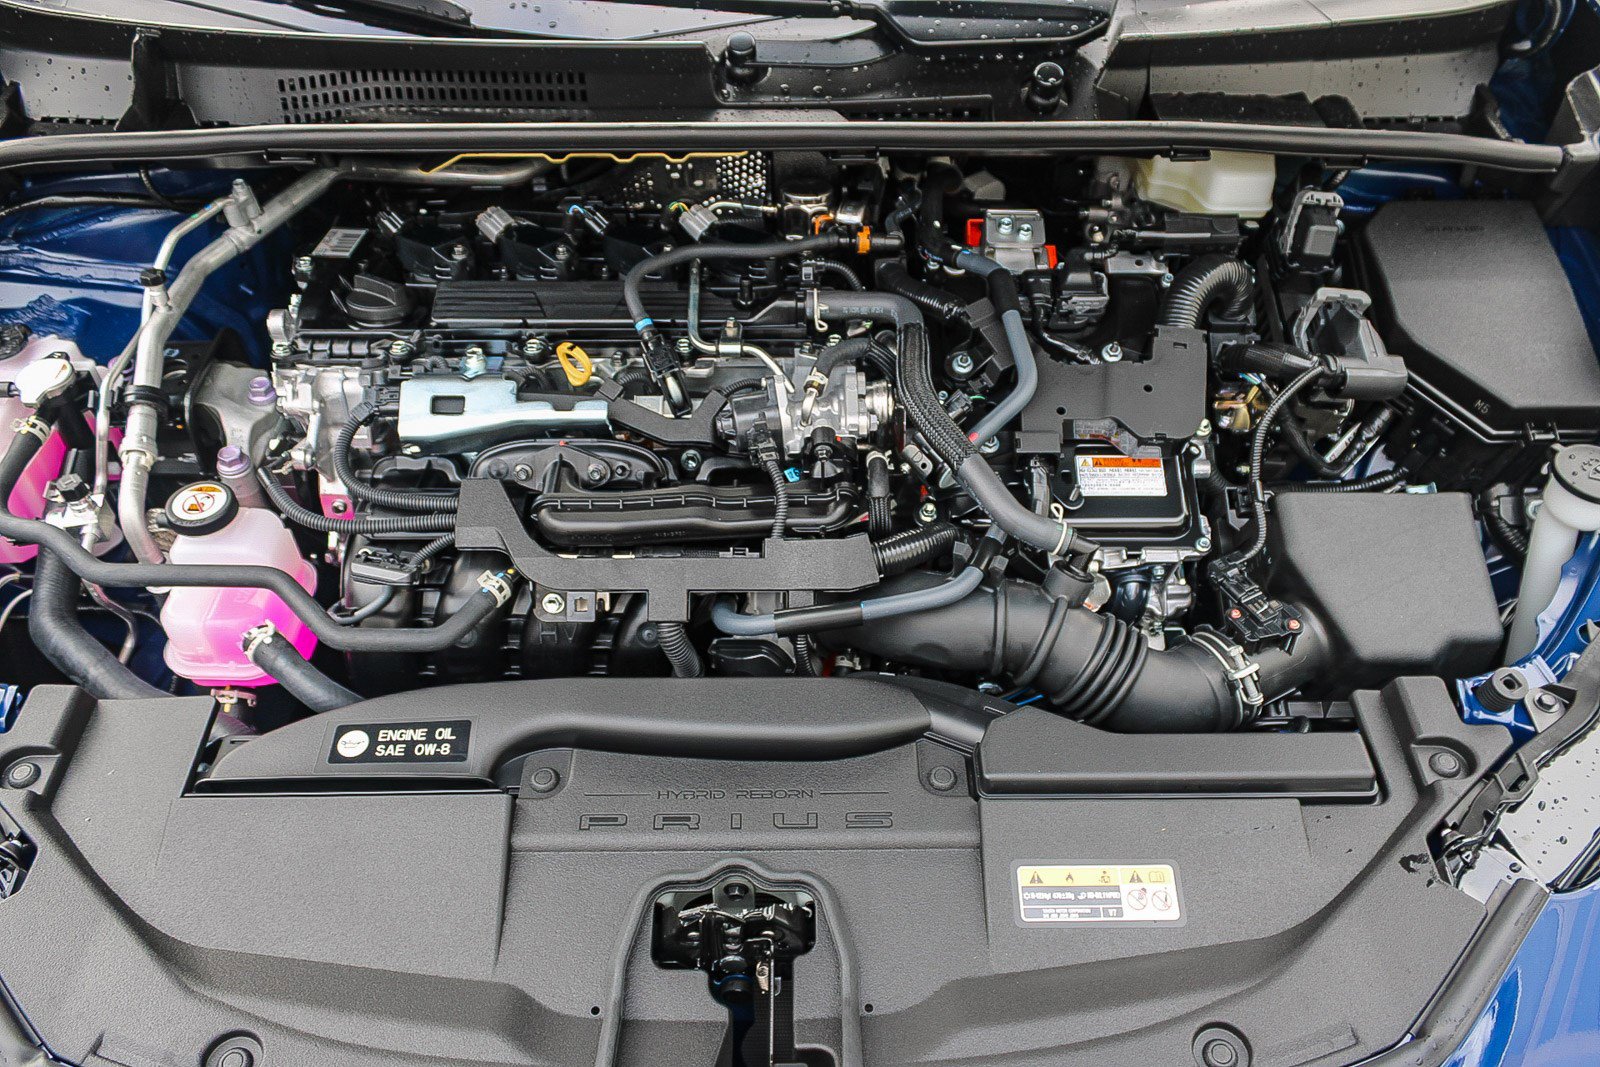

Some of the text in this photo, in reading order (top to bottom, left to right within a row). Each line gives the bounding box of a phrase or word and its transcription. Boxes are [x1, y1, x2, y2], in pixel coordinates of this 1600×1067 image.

[377, 727, 457, 742] ENGINE OIL
[375, 743, 451, 757] SAE 0W-8
[656, 788, 815, 801] HYBRID REBORN
[578, 811, 894, 831] PRIUS
